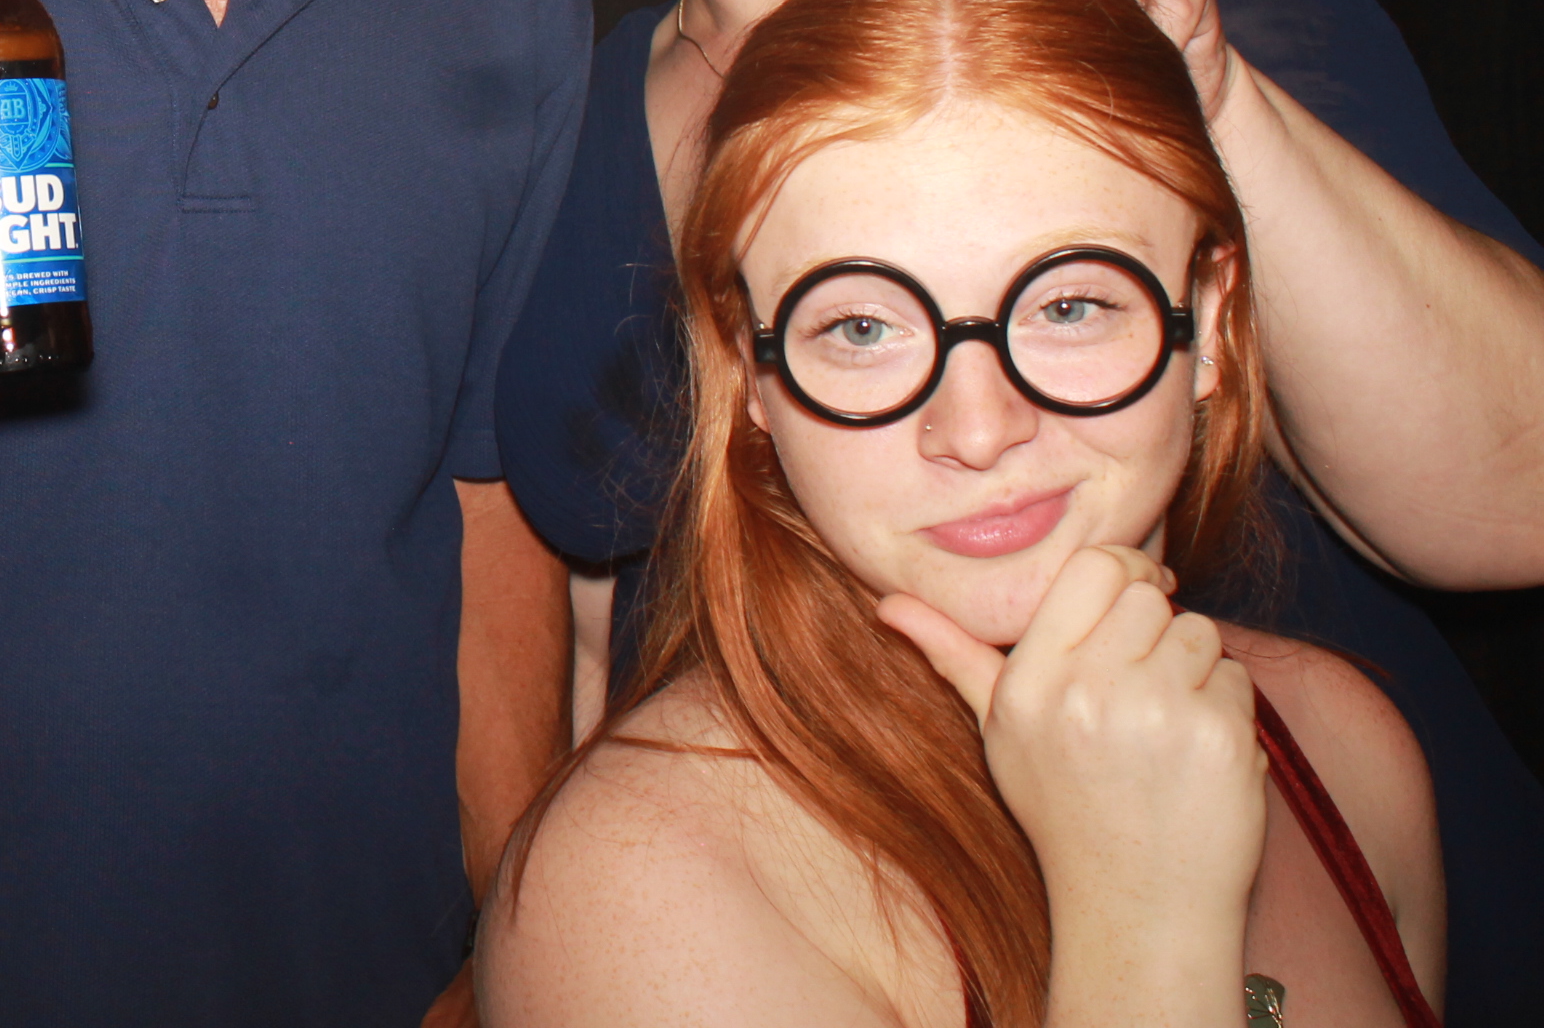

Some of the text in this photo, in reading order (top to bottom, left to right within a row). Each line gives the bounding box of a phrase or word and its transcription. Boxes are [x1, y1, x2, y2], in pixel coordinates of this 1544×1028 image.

[16, 271, 51, 281] BREWED
[52, 270, 69, 278] WITH
[30, 277, 76, 287] INGREDIENTS
[32, 286, 57, 295] CRISP
[58, 285, 76, 293] TASTE
